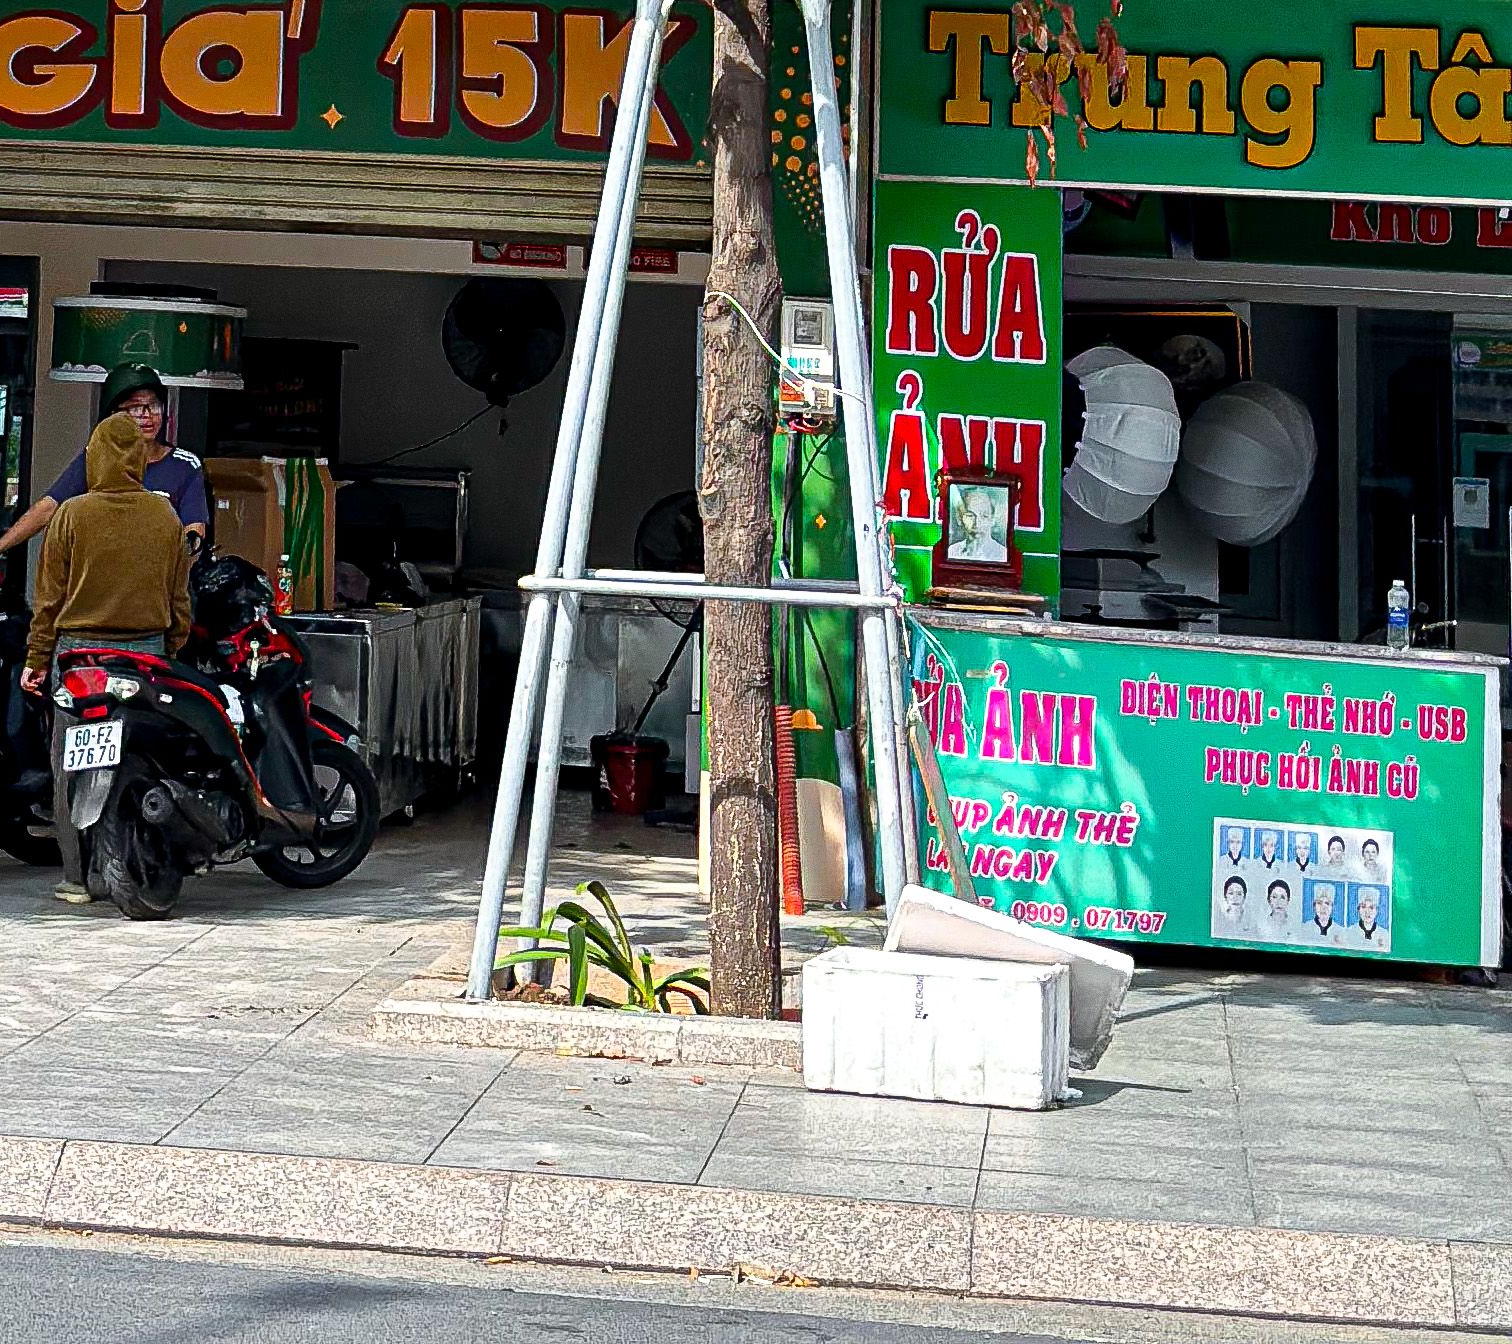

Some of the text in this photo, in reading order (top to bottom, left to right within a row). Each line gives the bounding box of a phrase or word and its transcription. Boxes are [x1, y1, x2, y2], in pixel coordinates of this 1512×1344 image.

[386, 7, 681, 148] 15K
[928, 9, 1323, 169] Trung
[886, 209, 1046, 364] RỬA
[883, 370, 1046, 532] ẢNH
[75, 726, 113, 748] 60-F2
[979, 659, 1096, 769] ẢNH
[1120, 672, 1180, 726] ĐIỆN
[1187, 684, 1264, 734] THOẠI
[1284, 683, 1337, 733] THẺ
[1342, 690, 1397, 738] NHỚ
[1417, 704, 1469, 744] USB
[67, 744, 117, 768] 376.70
[1204, 746, 1271, 796] PHỤC
[1327, 744, 1381, 798] ẢNH
[1385, 755, 1420, 801] CŨ
[993, 791, 1066, 840] ẢNH
[1075, 801, 1140, 847] THẺ
[970, 844, 1056, 884] NGAY
[1011, 901, 1067, 925] 0909
[1084, 908, 1167, 935] 071797
